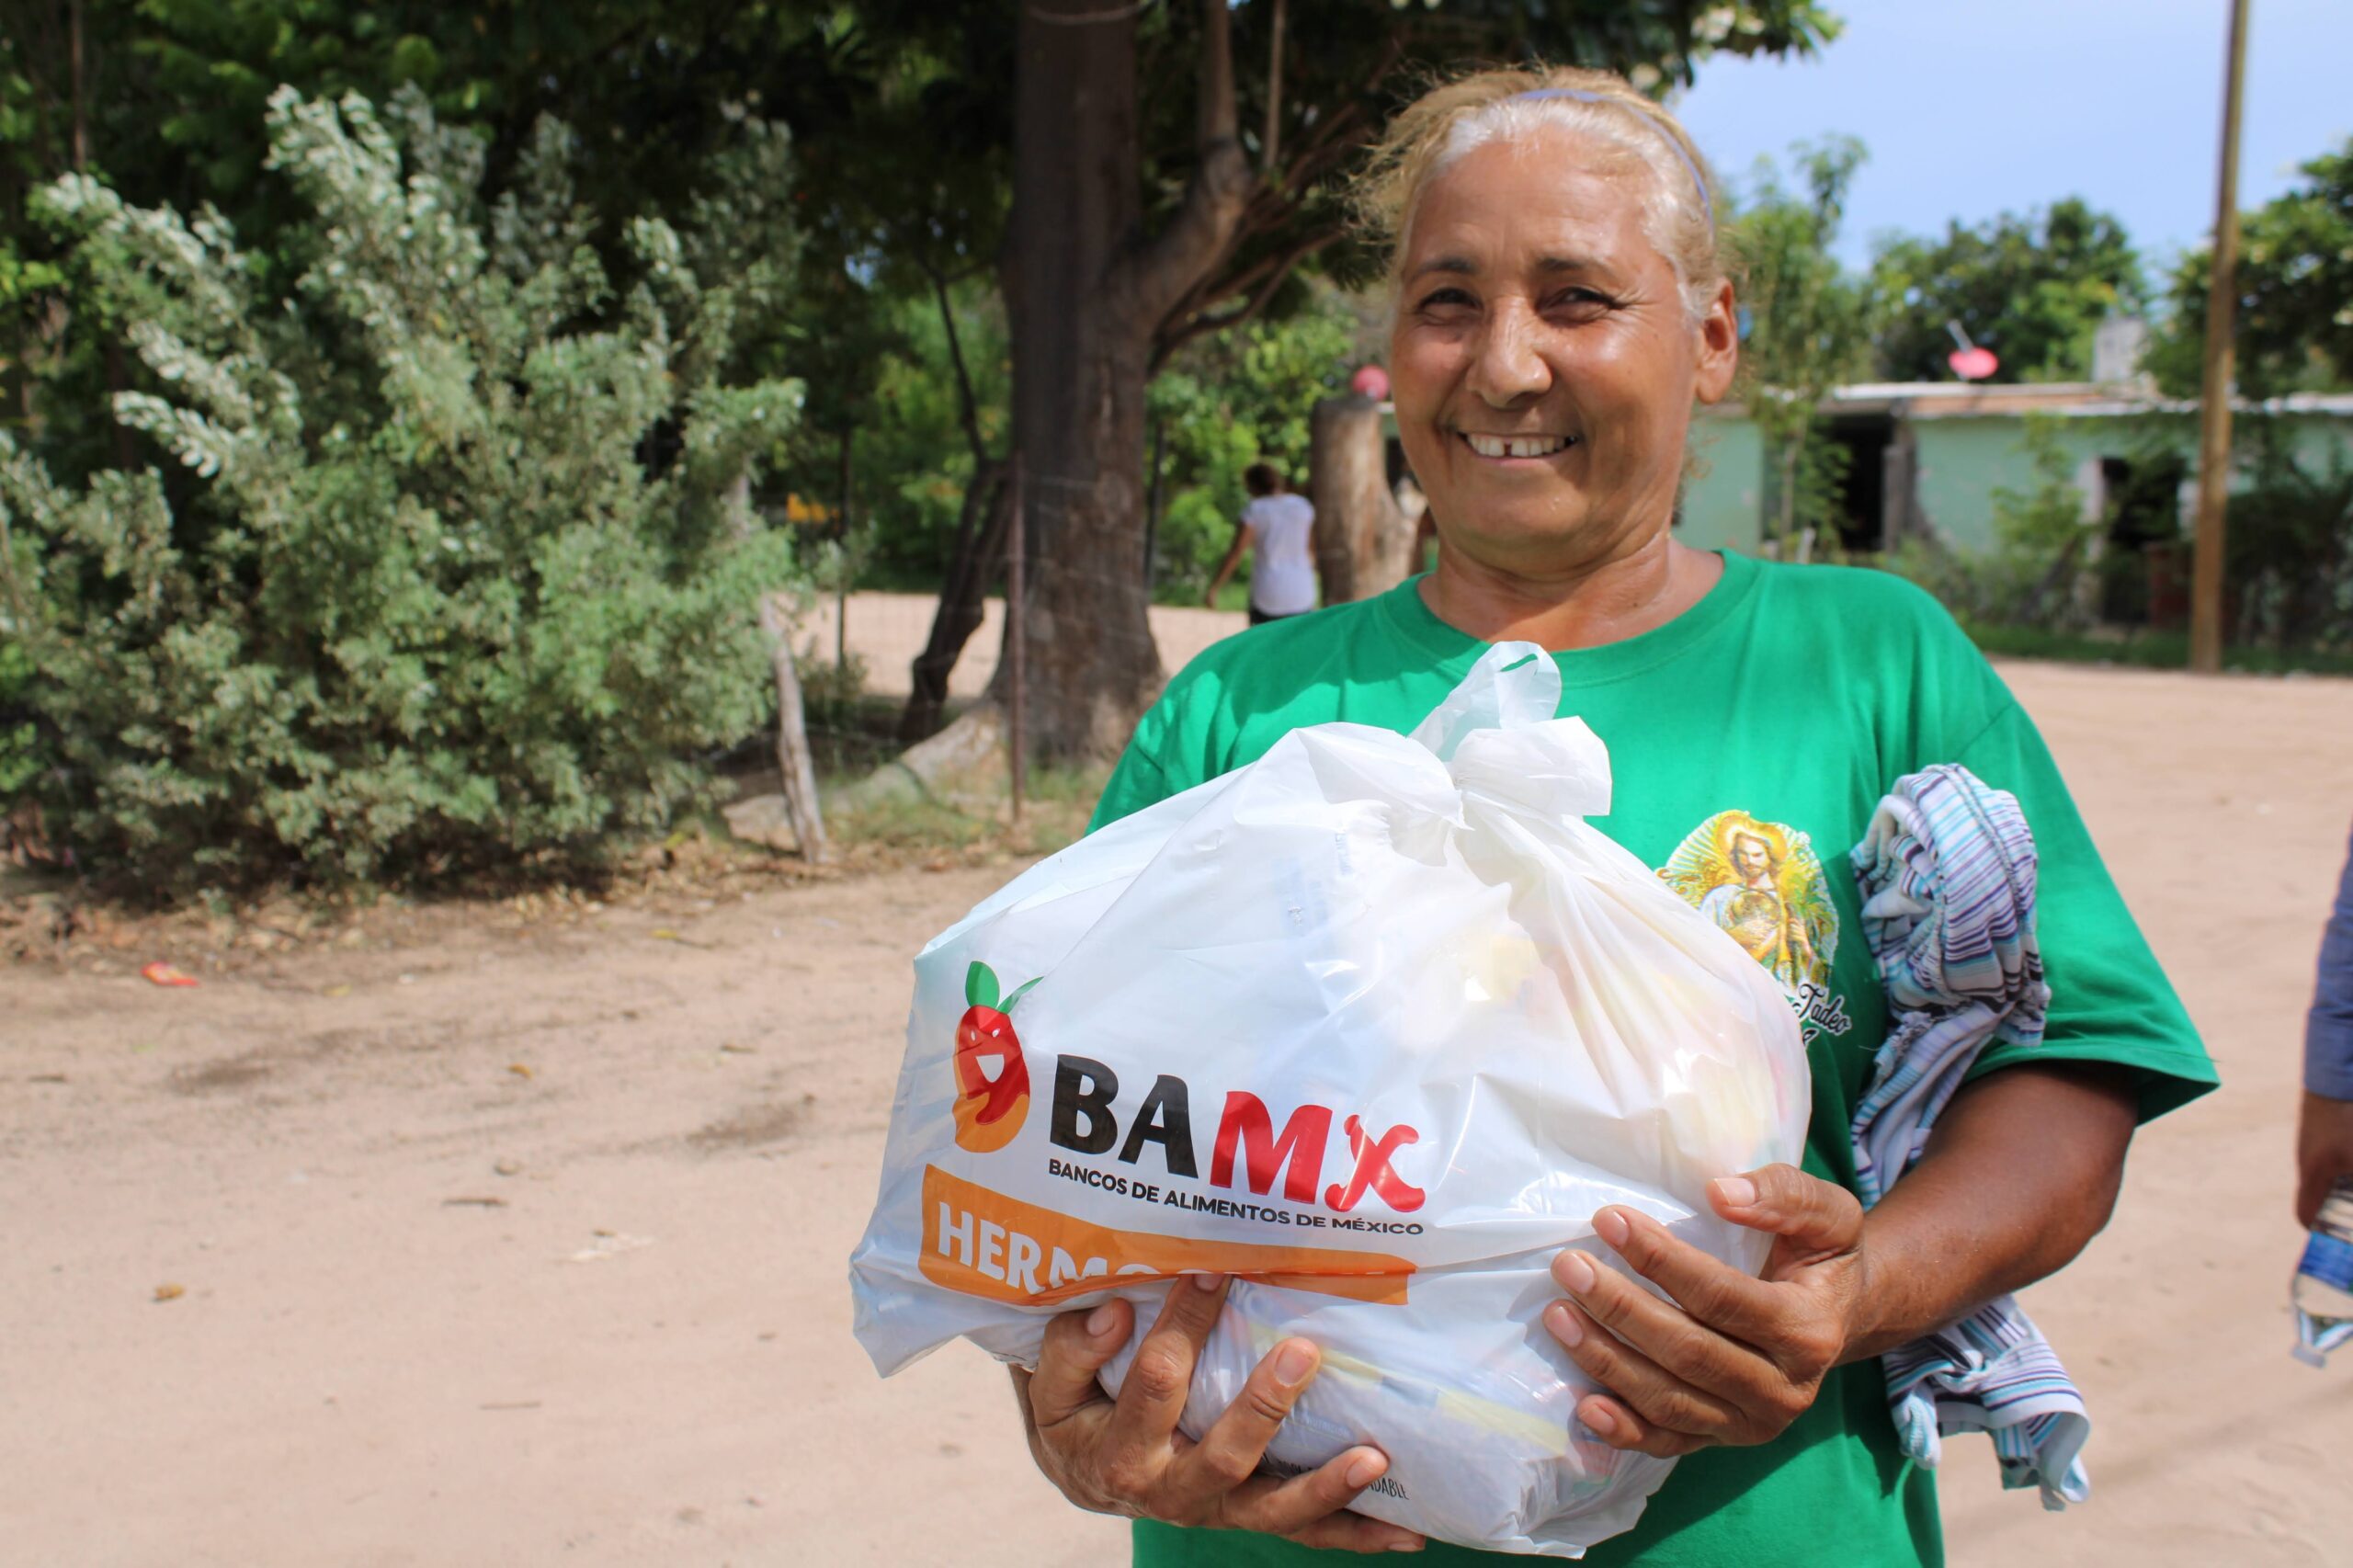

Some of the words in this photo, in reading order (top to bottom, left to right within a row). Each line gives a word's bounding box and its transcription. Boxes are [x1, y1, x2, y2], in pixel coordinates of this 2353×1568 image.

[1799, 983, 1850, 1033] Tadeo
[1049, 1053, 1426, 1212] BAMX
[1049, 1158, 1128, 1196] BANCOS
[1131, 1181, 1160, 1203] DE
[1164, 1189, 1290, 1224] ALIMENTOS
[1296, 1213, 1326, 1228] DE
[1332, 1218, 1424, 1235] MÉXICO
